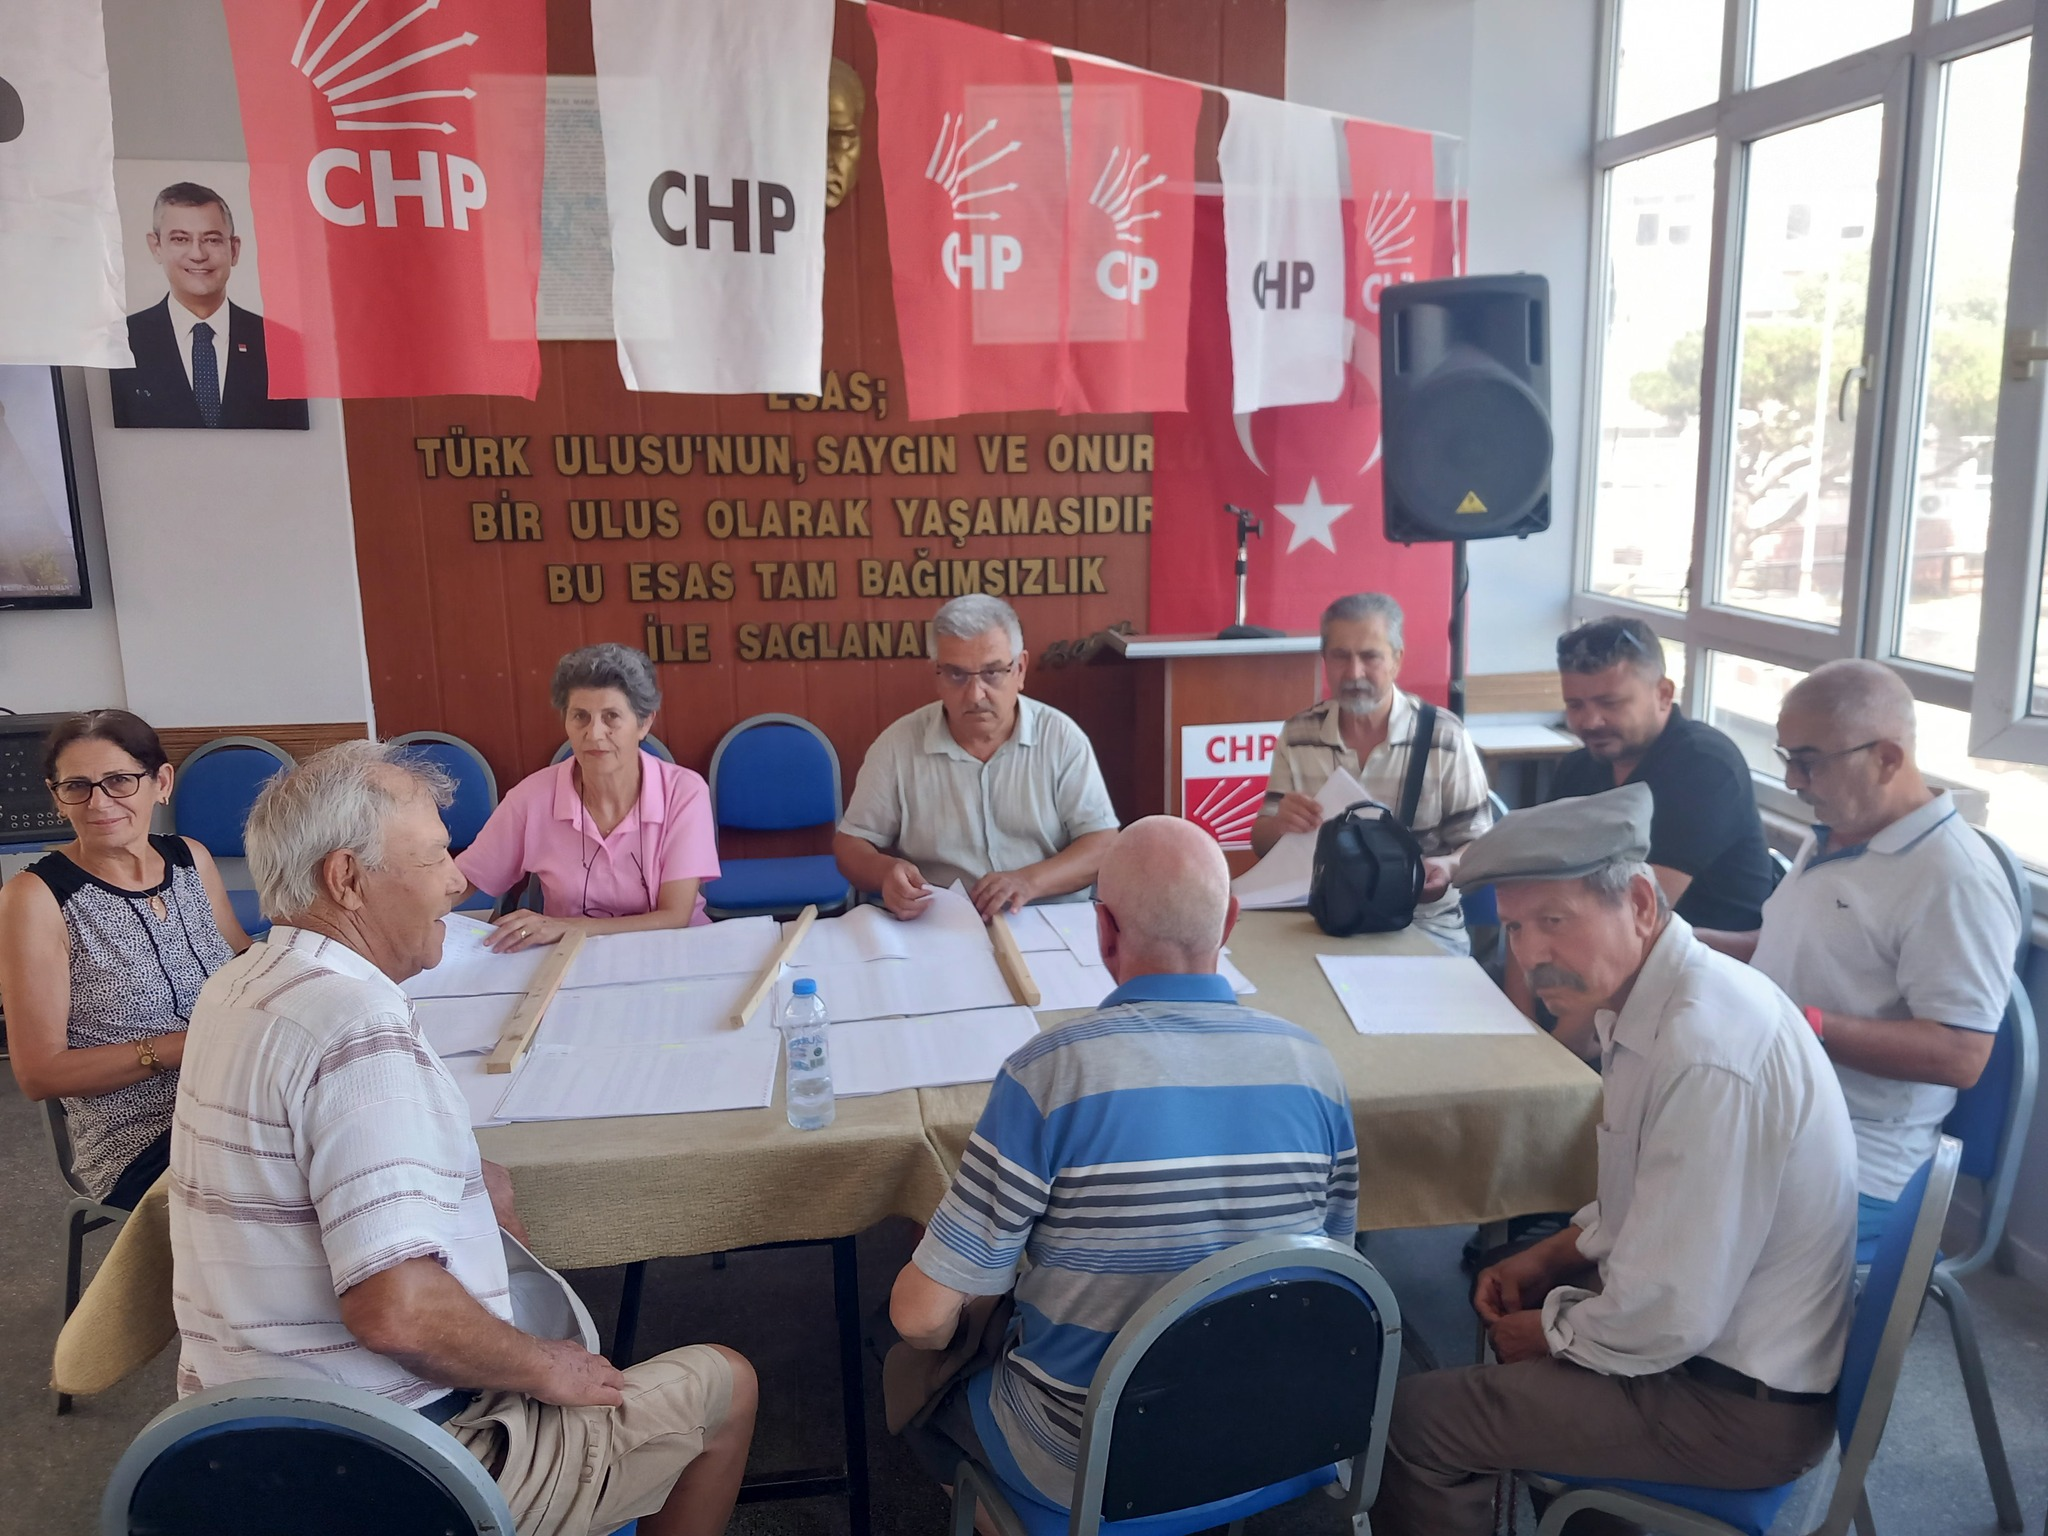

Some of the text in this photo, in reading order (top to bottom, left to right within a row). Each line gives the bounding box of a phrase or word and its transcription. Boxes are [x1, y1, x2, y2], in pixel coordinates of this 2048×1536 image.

[306, 148, 488, 231] CHP
[648, 170, 796, 254] CHP
[416, 426, 1154, 483] TÜRK ULUSU'NUN, SAYGIN VE ONUR
[472, 489, 542, 541] BİR
[569, 500, 680, 539] ULUS
[706, 498, 870, 539] OLARAK
[547, 549, 1107, 603] BU ESAS TAM BAĞIMSIZLIK
[646, 613, 710, 662] İLE
[1206, 734, 1279, 763] CHP
